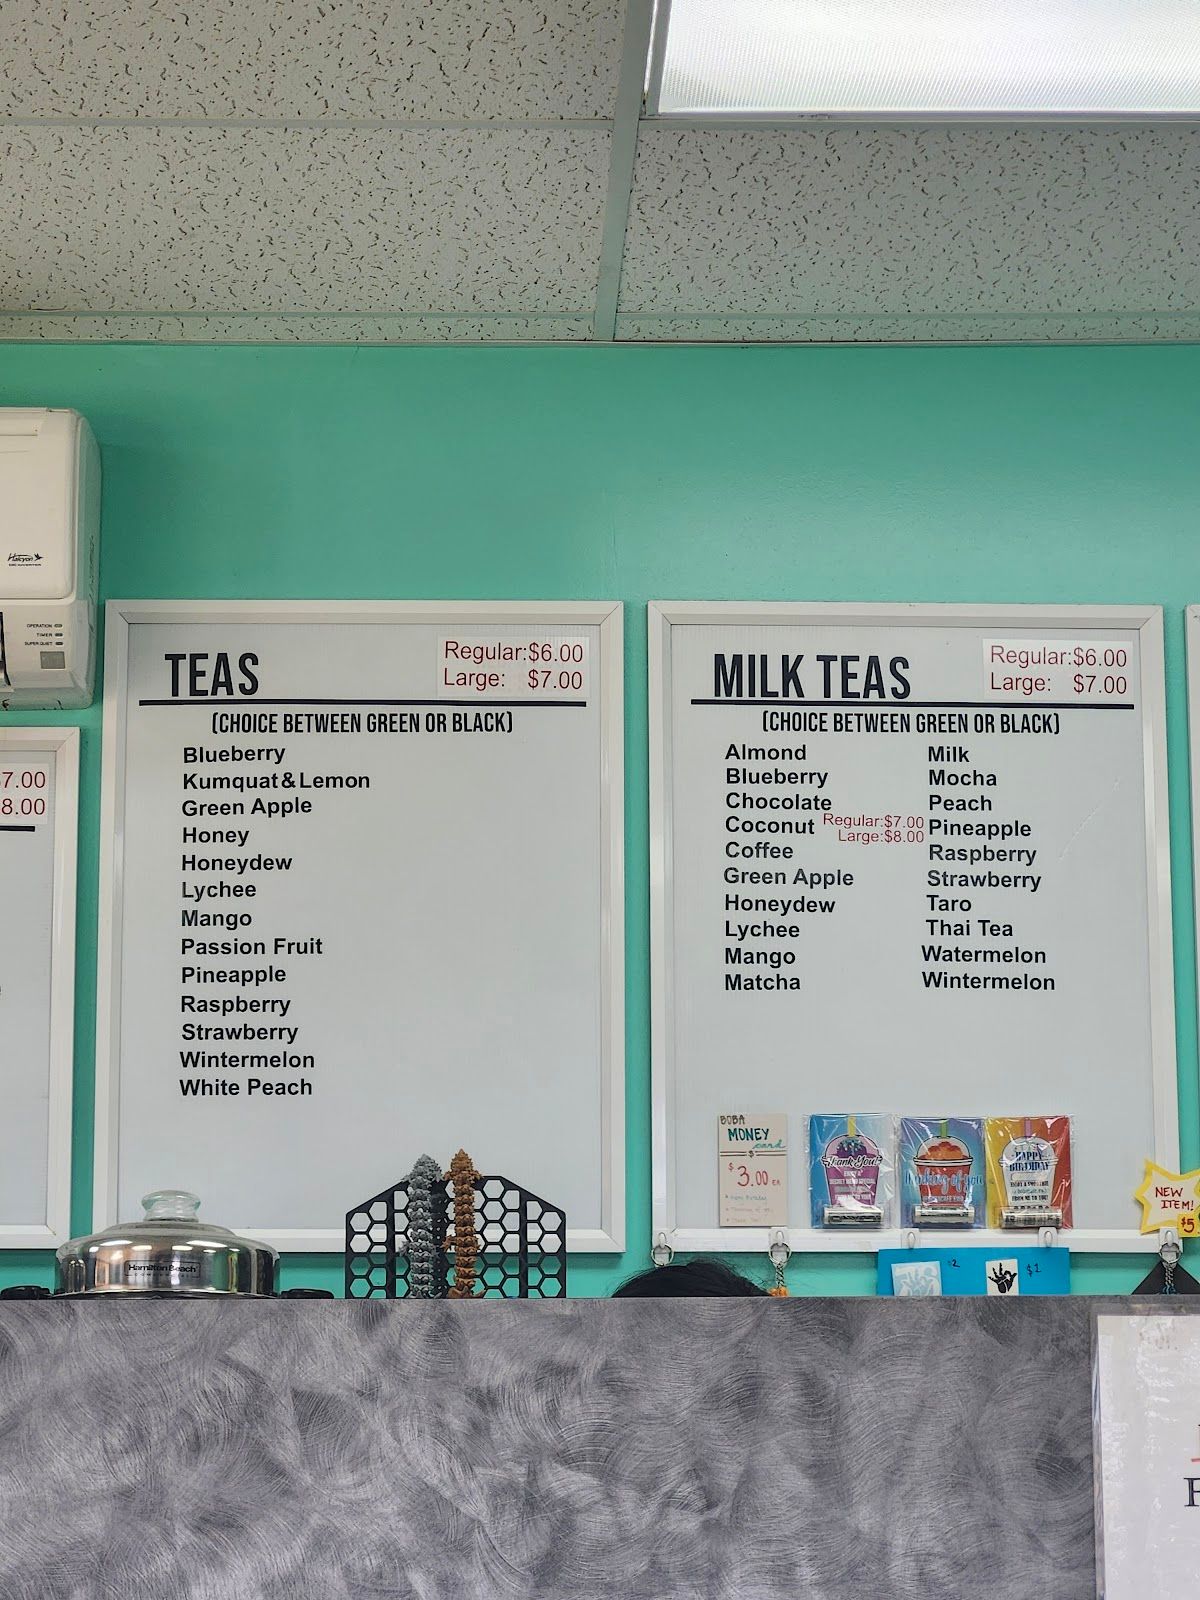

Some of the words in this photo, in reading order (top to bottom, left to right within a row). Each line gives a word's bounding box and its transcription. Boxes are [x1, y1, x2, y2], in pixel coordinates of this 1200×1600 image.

[163, 650, 261, 698] TEAS
[445, 668, 504, 691] Large:
[528, 669, 582, 690] $7.00
[713, 652, 806, 699] MILK
[816, 654, 912, 700] TEAS
[992, 672, 1050, 695] Large:
[1074, 674, 1126, 694] $7.00
[284, 713, 360, 733] BETWEEN
[367, 713, 419, 732] GREEN
[426, 713, 446, 732] OR
[834, 713, 910, 732] BETWEEN
[916, 714, 968, 733] GREEN
[974, 714, 994, 733] OR
[184, 745, 285, 764] Blueberry
[725, 744, 806, 760] Almond
[929, 746, 969, 762] Milk
[0, 772, 45, 788] 7.00
[727, 768, 828, 788] Blueberry
[929, 770, 996, 786] Mocha
[182, 800, 244, 816] Green
[251, 797, 311, 818] Apple
[726, 792, 831, 810] Chocolate
[930, 795, 991, 811] Peach
[726, 816, 814, 834] Coconut
[929, 819, 1031, 840] Pineapple
[183, 827, 249, 847] Honey
[726, 842, 793, 858] Coffee
[930, 844, 1036, 866] Raspberry
[182, 854, 292, 875] Honeydew
[724, 867, 786, 884] Green
[793, 869, 853, 889] Apple
[928, 870, 1041, 892] Strawberry
[183, 881, 256, 901] Lychee
[726, 894, 835, 916] Honeydew
[926, 895, 971, 911] Taro
[182, 910, 252, 930] Mango
[926, 920, 970, 936] Thai
[978, 920, 1013, 936] Tea
[726, 921, 799, 941] Lychee
[182, 938, 265, 954] Passion
[274, 938, 322, 954] Fruit
[922, 945, 1045, 963] Watermelon
[726, 948, 795, 968] Mango
[182, 965, 286, 986] Pineapple
[725, 974, 800, 990] Matcha
[922, 972, 1054, 990] Wintermelon
[182, 996, 291, 1016] Raspberry
[182, 1024, 298, 1044] Strawberry
[180, 1051, 314, 1068] Wintermelon
[180, 1079, 239, 1096] White
[248, 1079, 312, 1095] Peach
[720, 1114, 746, 1125] BOBA
[727, 1128, 770, 1142] MONEY
[752, 1140, 786, 1149] card
[1015, 1152, 1043, 1161] HAPPY
[1009, 1161, 1050, 1172] BIRTHDAY
[1155, 1187, 1183, 1198] NEW
[1161, 1200, 1194, 1211] ITEM!
[1180, 1216, 1195, 1233] $5
[128, 1264, 168, 1272] Hamilton
[168, 1265, 196, 1273] Beach
